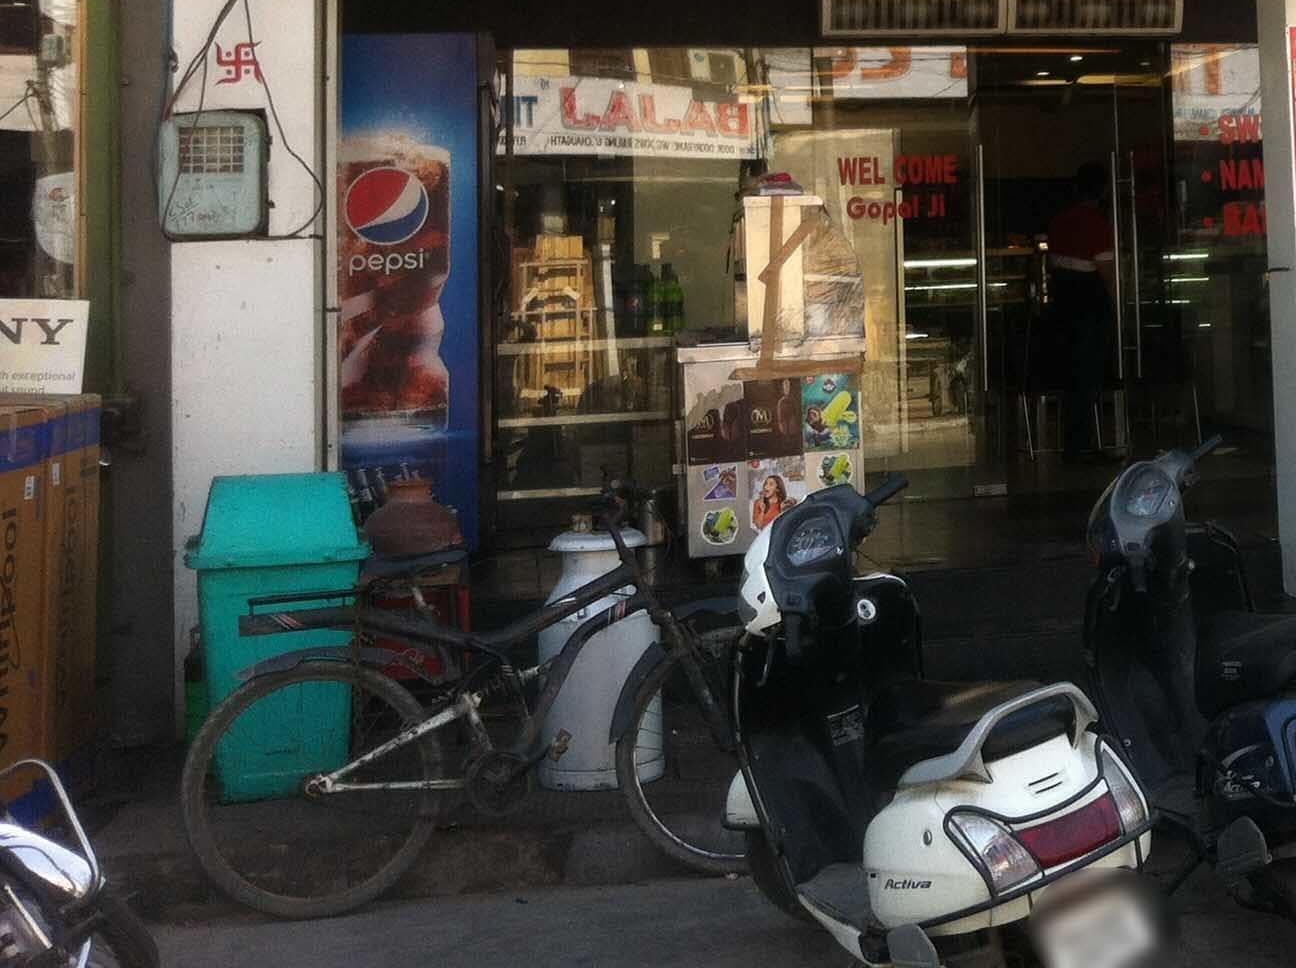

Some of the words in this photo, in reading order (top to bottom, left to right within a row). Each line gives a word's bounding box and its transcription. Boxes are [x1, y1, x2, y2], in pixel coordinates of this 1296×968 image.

[847, 194, 920, 225] Gopal
[349, 248, 424, 276] pepsi
[884, 878, 932, 889] Activa
